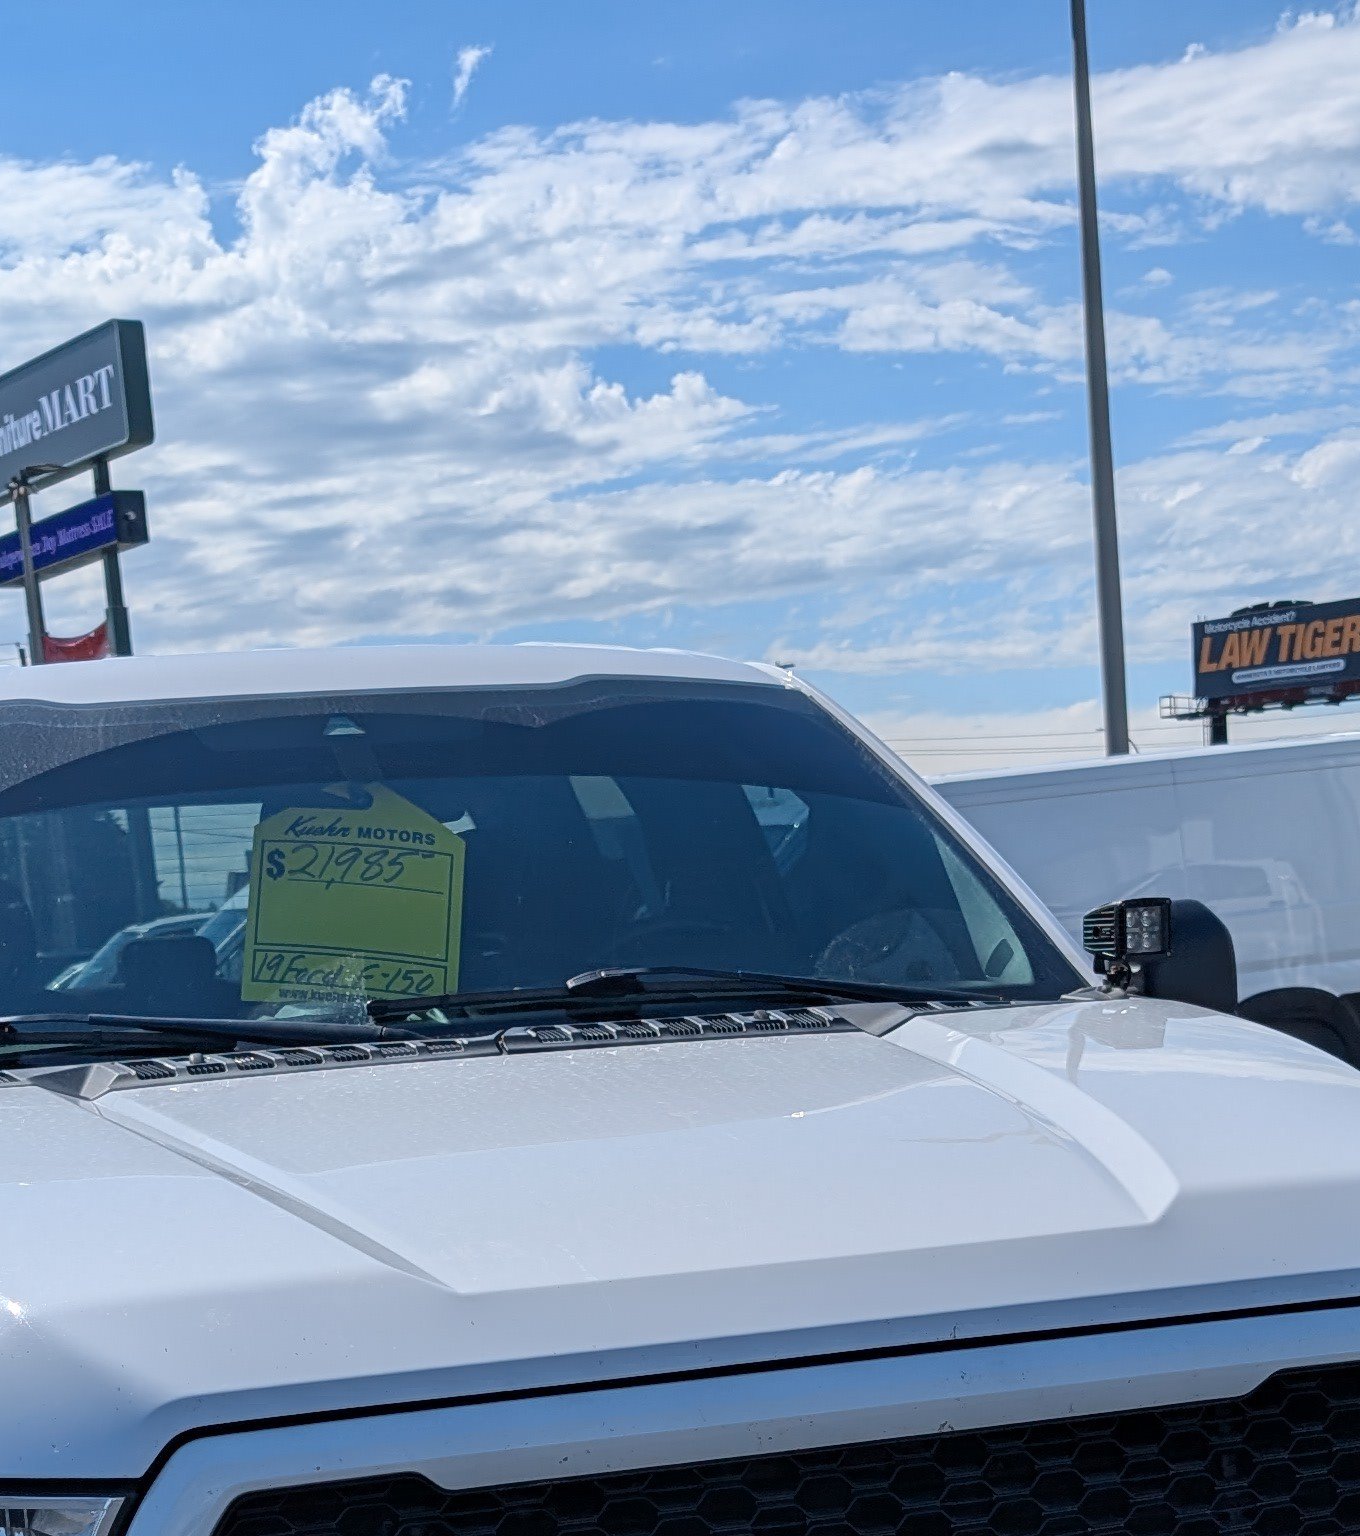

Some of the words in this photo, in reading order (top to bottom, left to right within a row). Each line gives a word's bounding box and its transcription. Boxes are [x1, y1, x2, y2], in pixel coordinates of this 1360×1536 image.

[1199, 627, 1272, 673] LAW
[285, 815, 351, 839] Kuehn
[357, 828, 436, 846] MOTORS
[254, 952, 281, 983] 19
[282, 953, 344, 985] Ford
